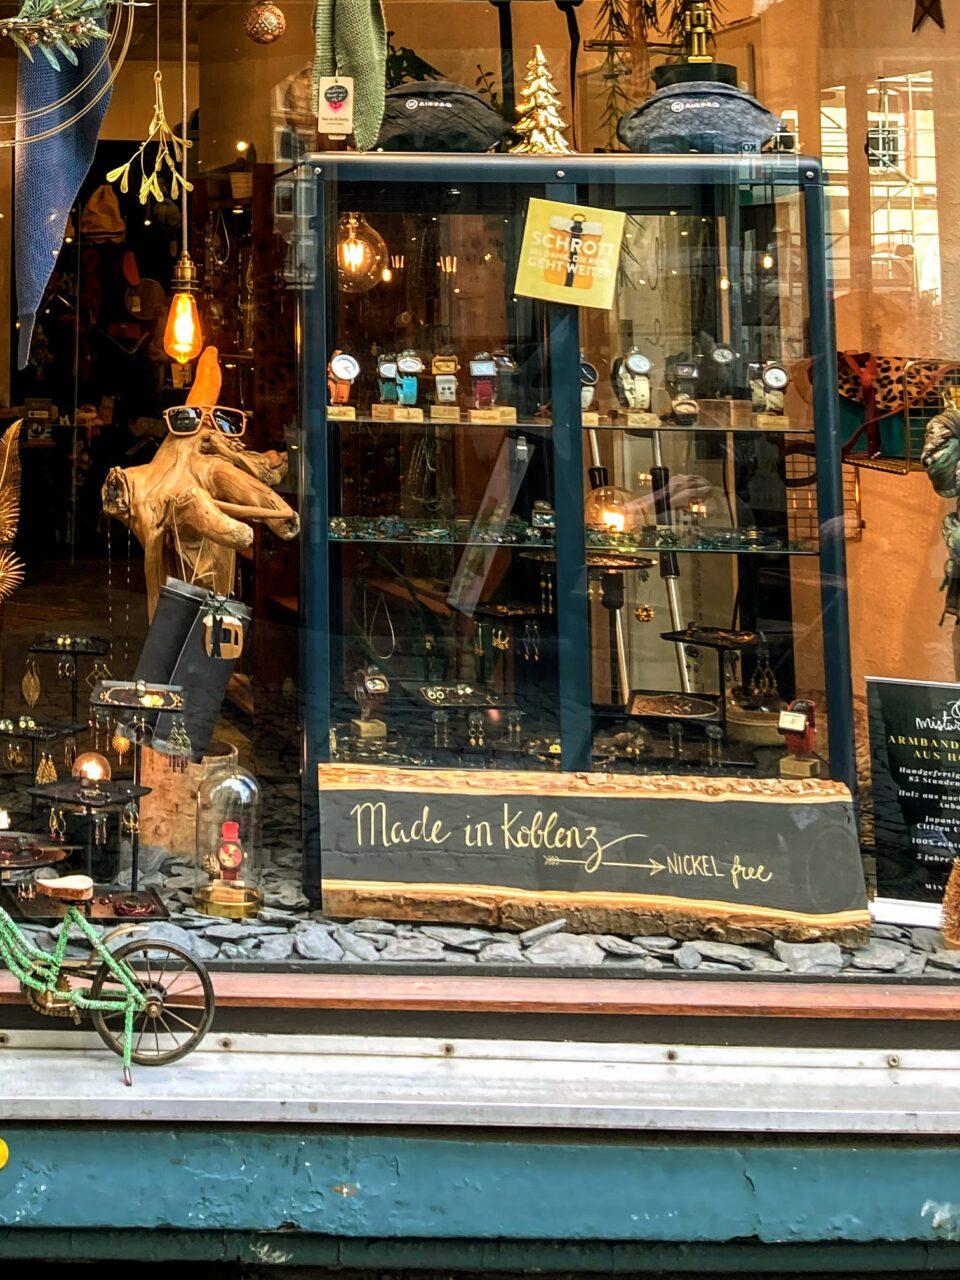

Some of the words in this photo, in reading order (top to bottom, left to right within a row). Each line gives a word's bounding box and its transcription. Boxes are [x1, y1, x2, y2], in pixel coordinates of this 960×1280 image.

[531, 230, 615, 258] SCHROTT
[350, 801, 452, 848] Made
[463, 815, 494, 848] in
[501, 802, 646, 874] Koblenz
[666, 853, 725, 878] NICKEL
[729, 855, 773, 889] free
